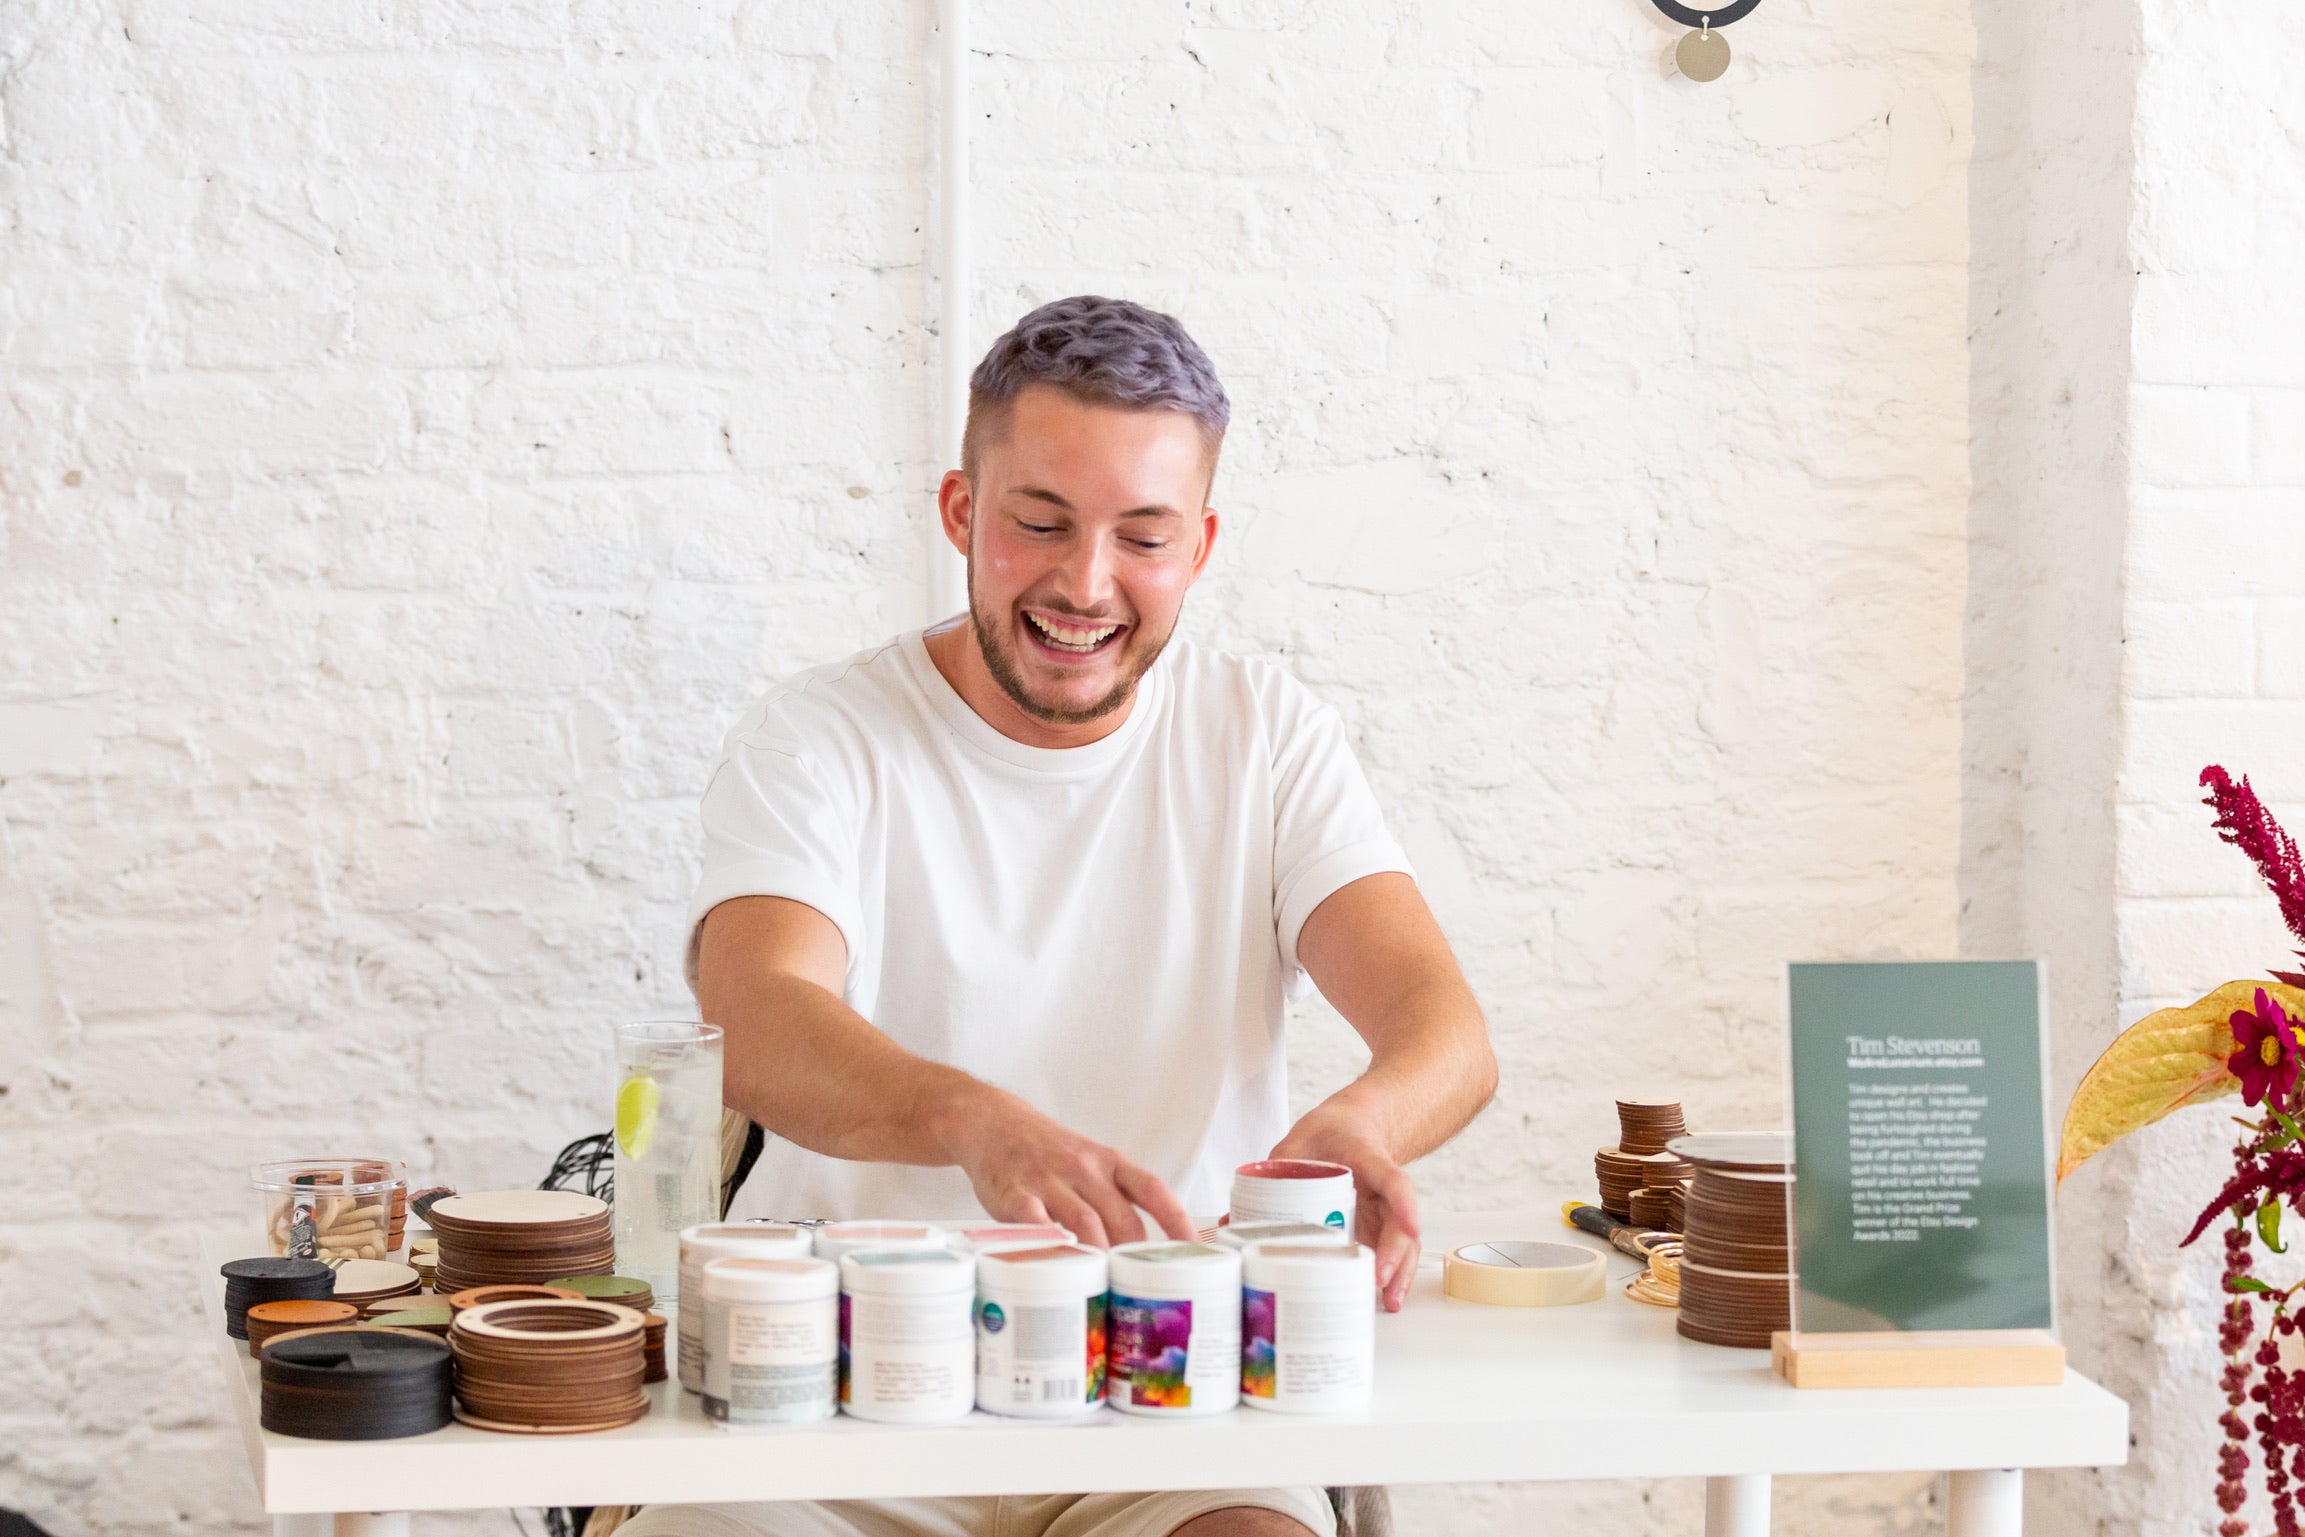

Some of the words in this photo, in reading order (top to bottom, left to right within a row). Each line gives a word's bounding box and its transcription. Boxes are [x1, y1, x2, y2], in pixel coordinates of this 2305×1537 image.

[1847, 1036, 1884, 1055] Tim
[1887, 1036, 1980, 1055] Stevenson
[1849, 1084, 1866, 1094] Tim
[1870, 1084, 1907, 1095] designs
[1911, 1084, 1930, 1094] and
[1848, 1099, 1883, 1108] unique
[1886, 1097, 1905, 1107] wall
[1929, 1097, 1943, 1106] He
[1947, 1096, 1987, 1106] decided
[1849, 1111, 1859, 1120] to
[1850, 1151, 1872, 1160] took
[1875, 1151, 1889, 1160] off
[1892, 1151, 1910, 1160] and
[1913, 1150, 1930, 1160] Tim
[1933, 1150, 1984, 1160] eventually
[1900, 1178, 1910, 1187] to
[1853, 1204, 1870, 1213] Tim
[1874, 1204, 1881, 1213] is
[1884, 1204, 1900, 1213] the
[1902, 1204, 1933, 1213] Grand
[1936, 1204, 1960, 1213] Prize
[1853, 1217, 1886, 1227] winner
[1889, 1217, 1900, 1227] of
[1903, 1217, 1918, 1227] the
[1921, 1217, 1941, 1227] Etsy
[1943, 1217, 1979, 1228] Design
